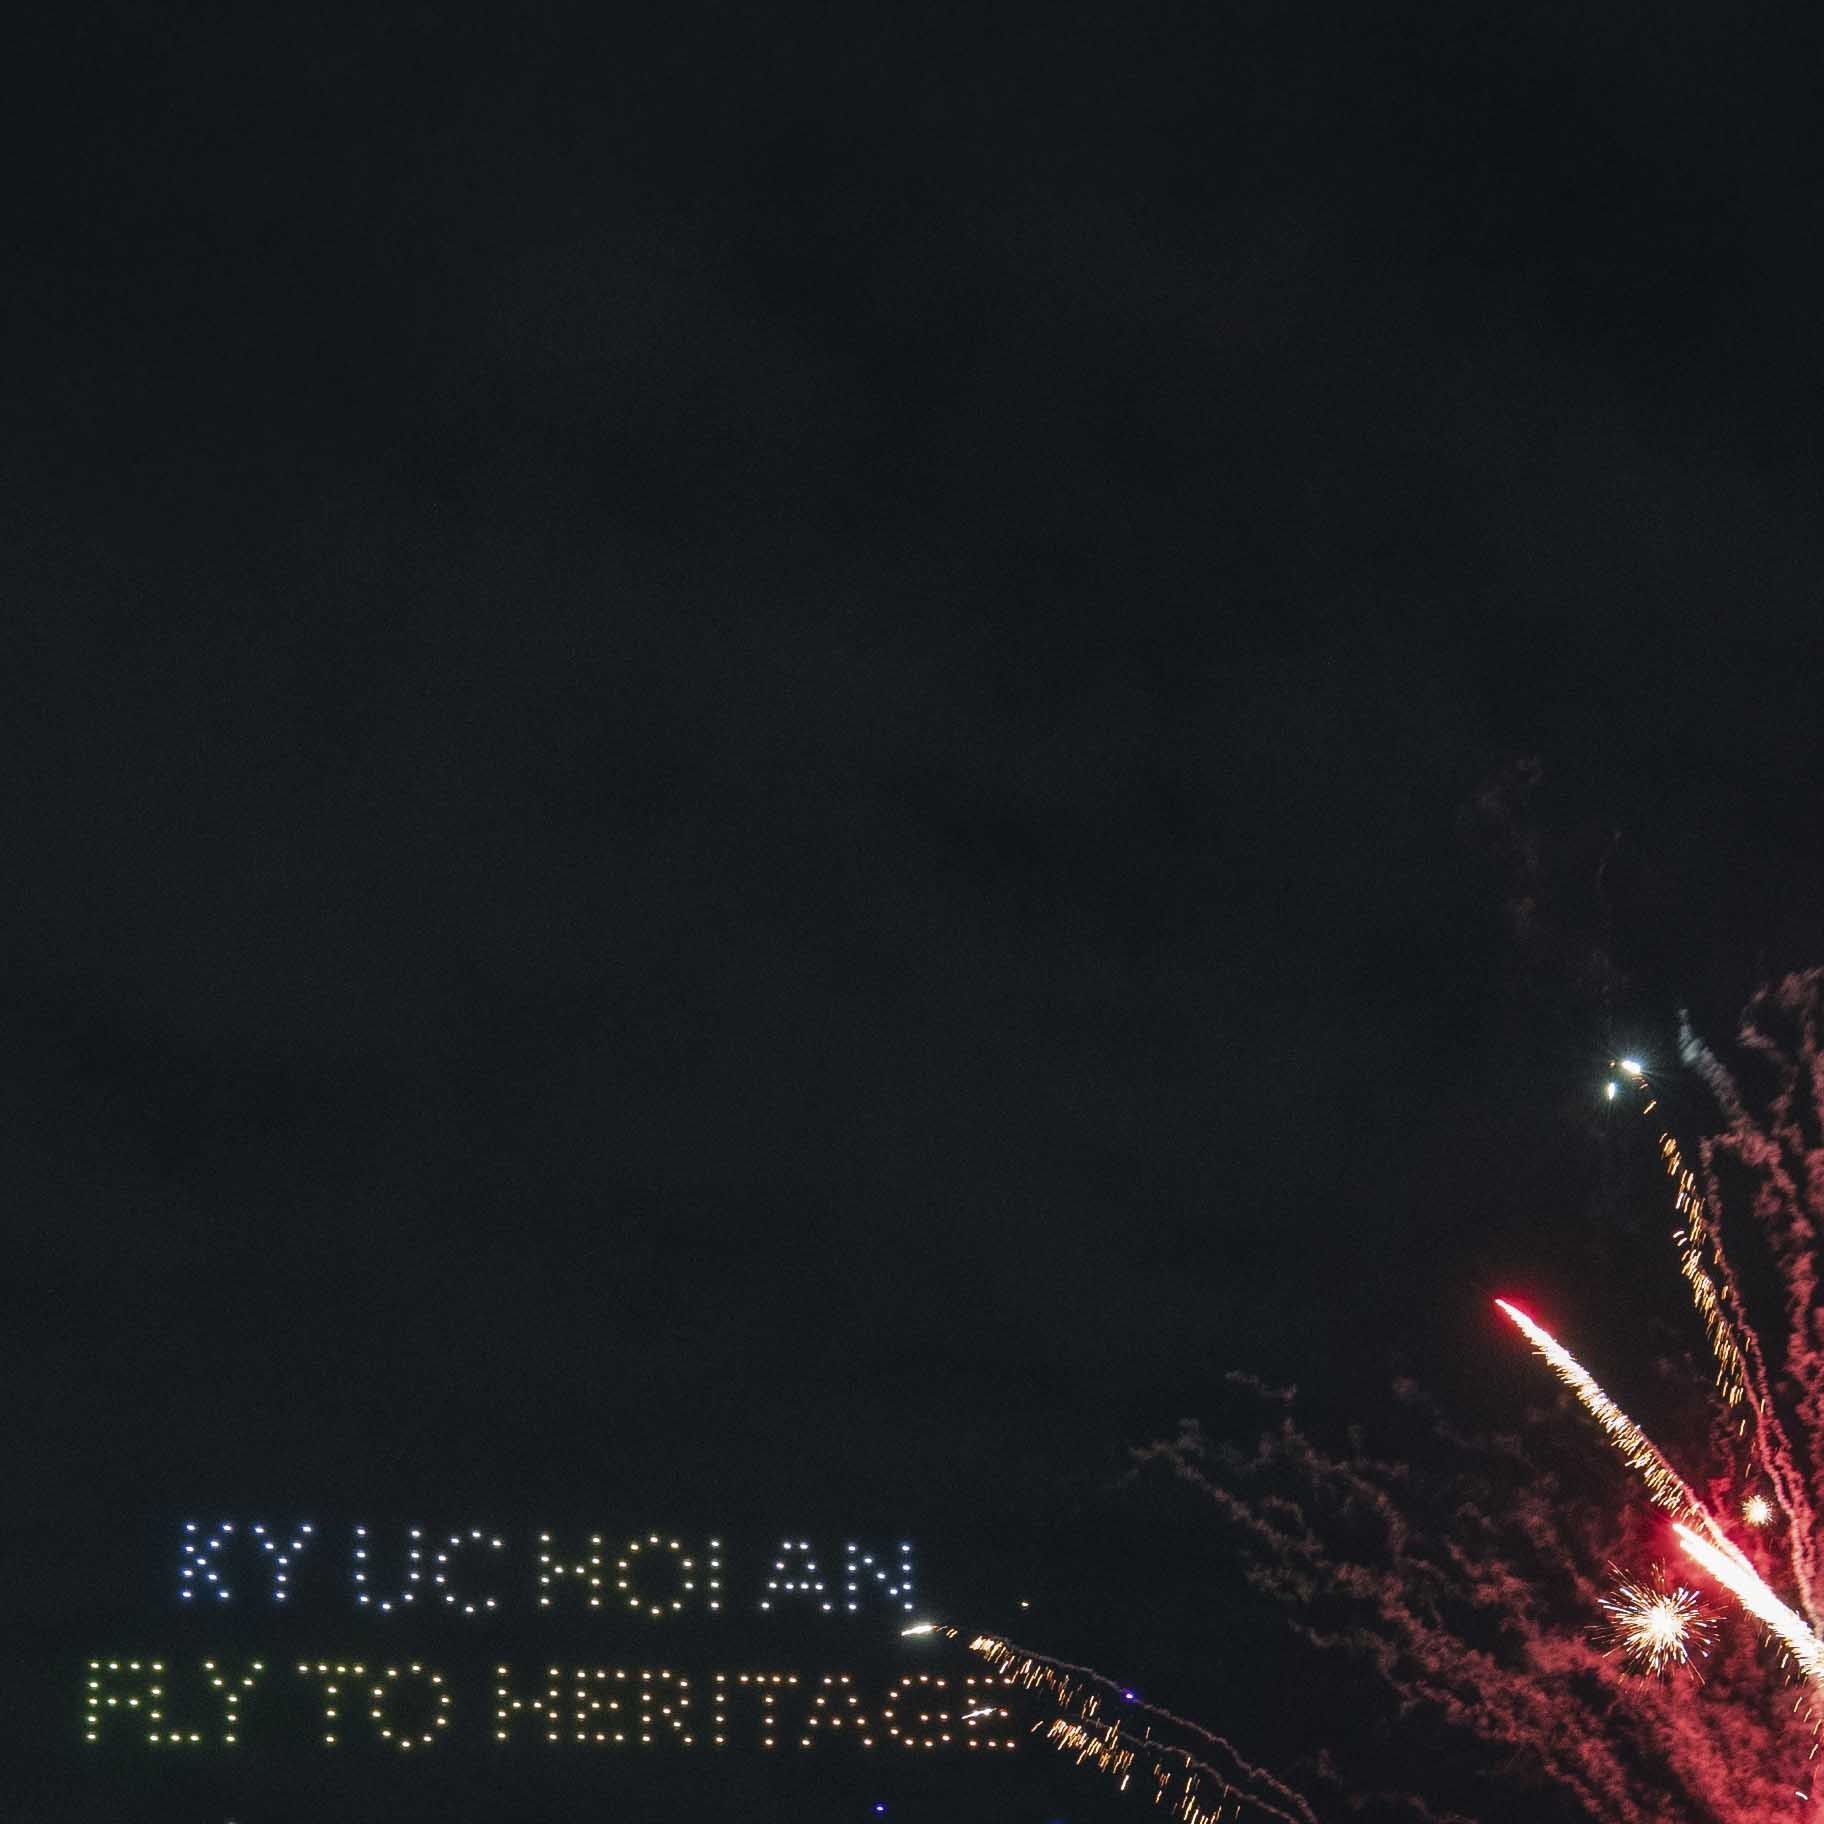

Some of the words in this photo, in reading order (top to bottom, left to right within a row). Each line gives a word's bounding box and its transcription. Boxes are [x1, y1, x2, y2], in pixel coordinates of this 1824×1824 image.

[179, 1522, 314, 1601] KY
[354, 1525, 504, 1614] UC
[539, 1532, 722, 1615] HOI
[761, 1540, 914, 1611] AN
[85, 1660, 265, 1743] FLY
[298, 1662, 451, 1748] TO
[496, 1664, 1016, 1750] HERITAGE
